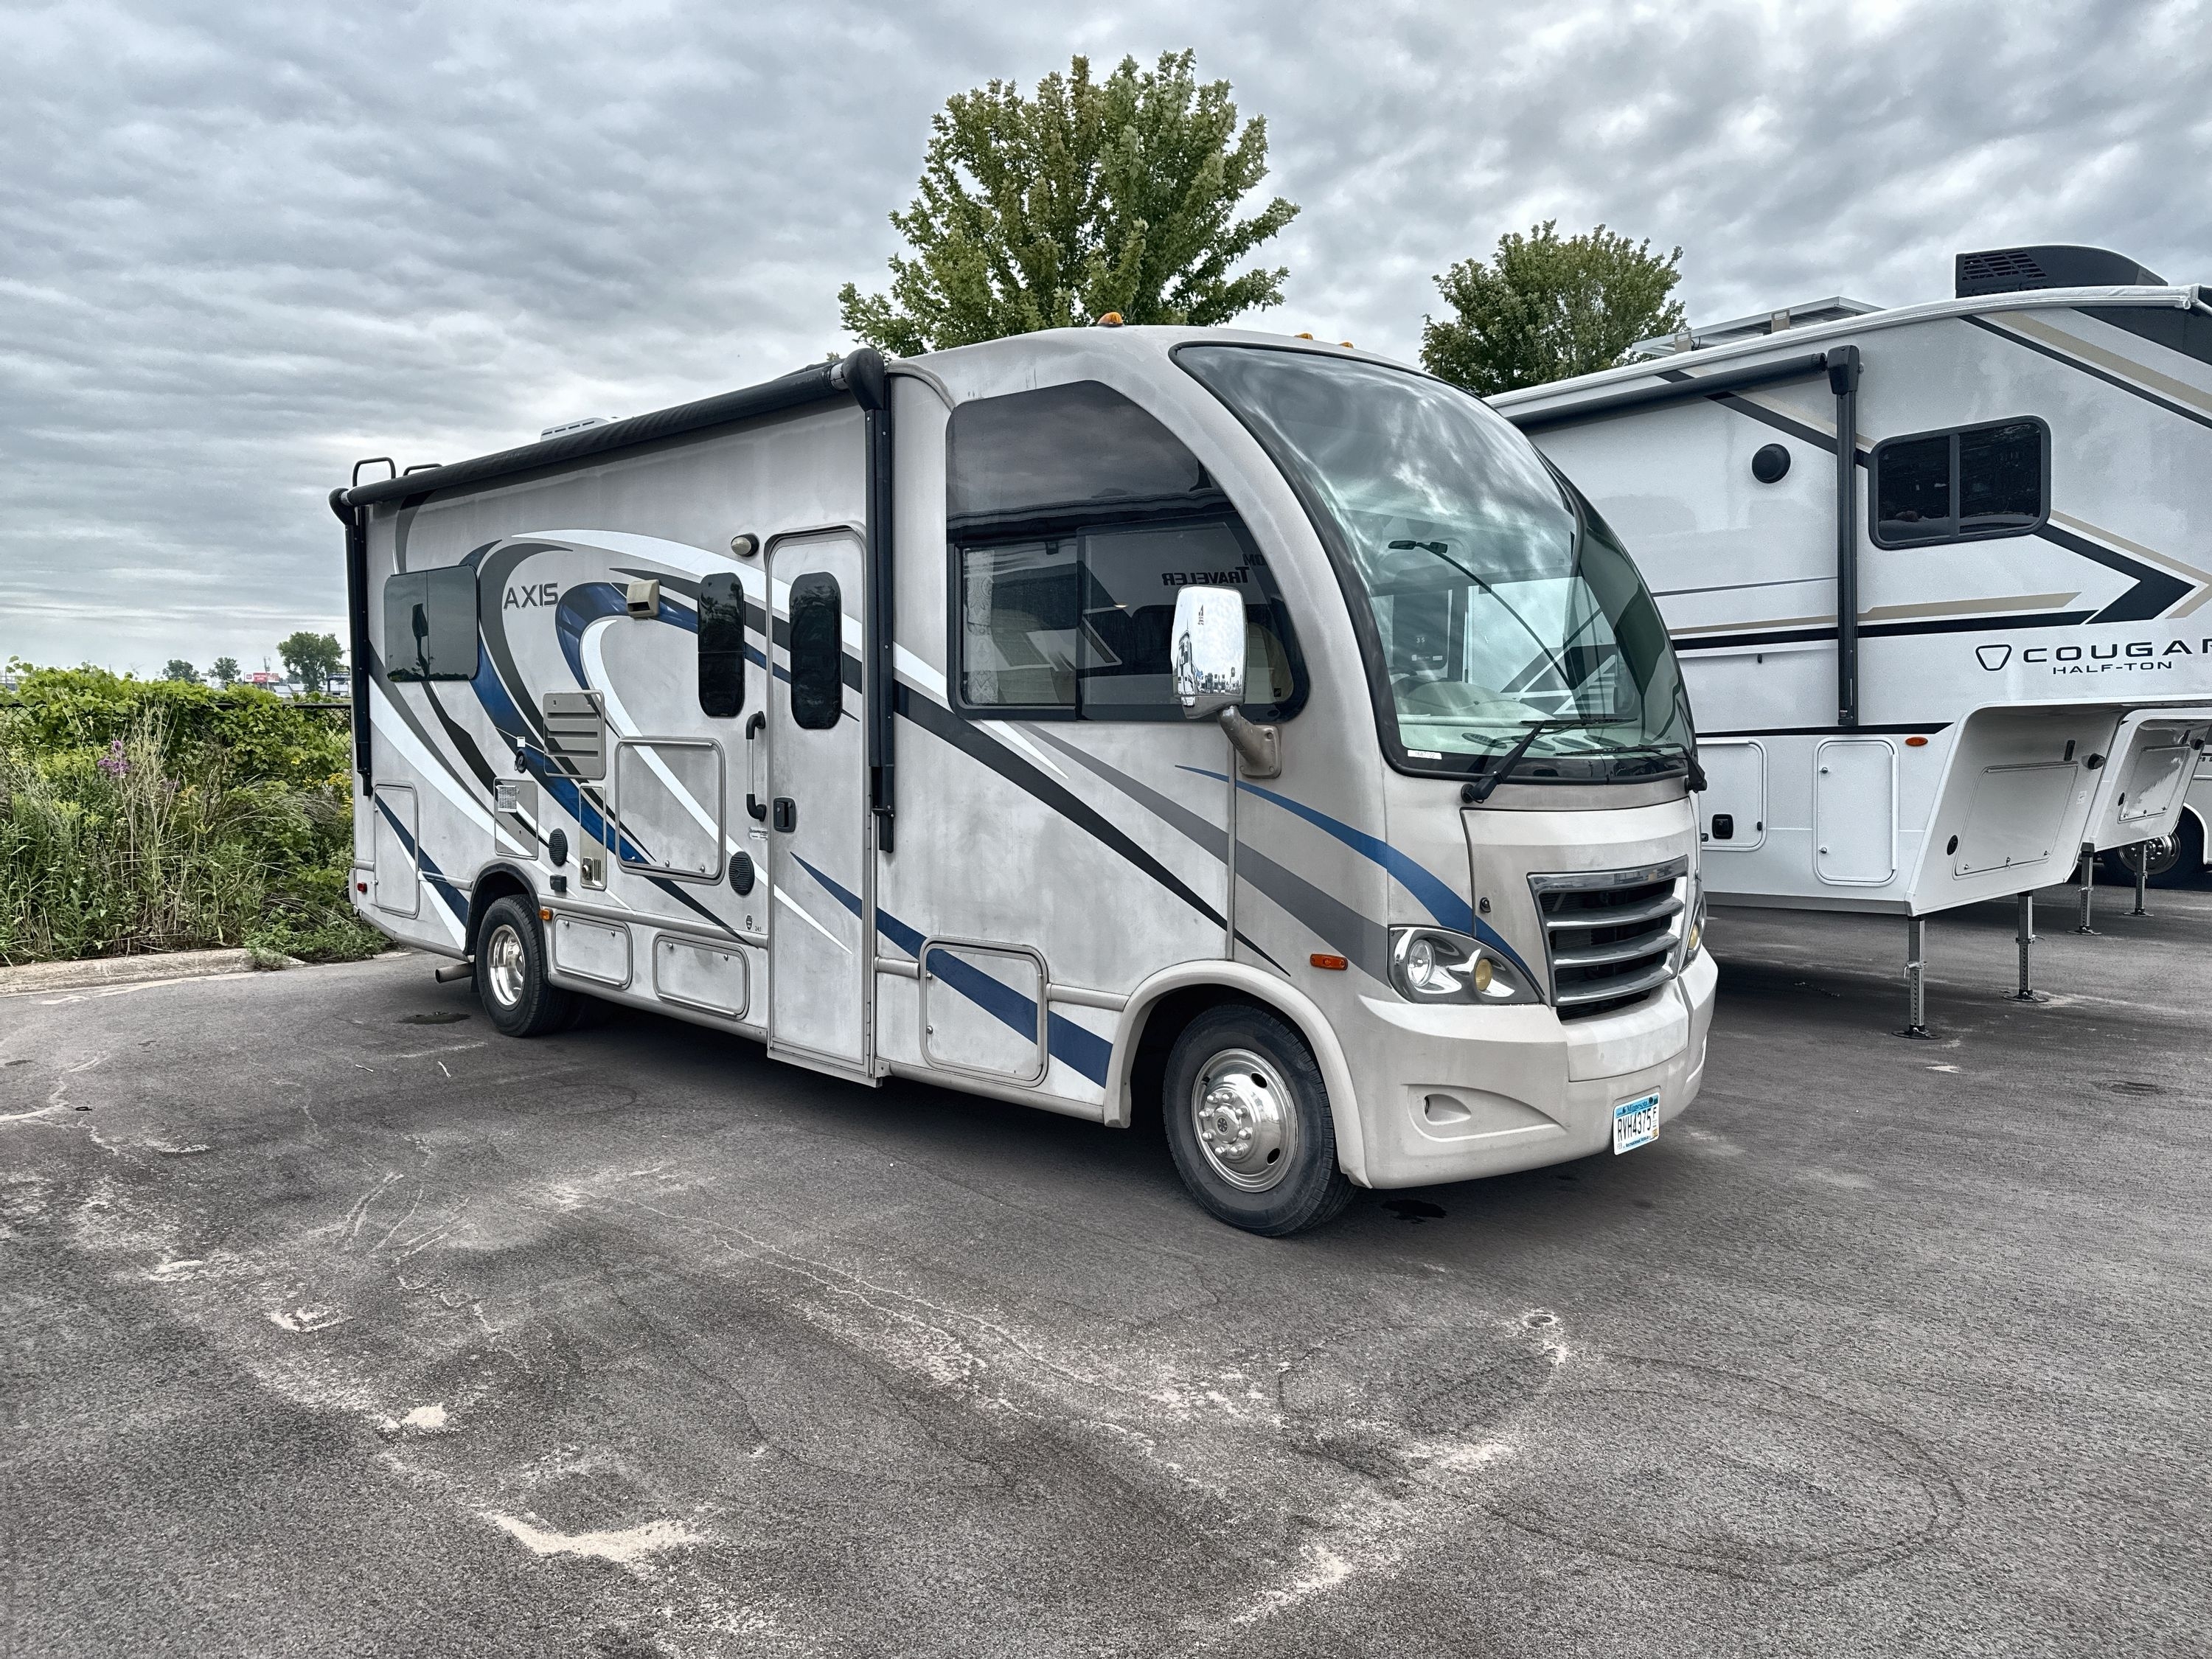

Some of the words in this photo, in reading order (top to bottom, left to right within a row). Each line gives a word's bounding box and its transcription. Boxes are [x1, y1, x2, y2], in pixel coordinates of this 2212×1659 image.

[503, 582, 559, 610] AXIS
[2053, 661, 2172, 675] HALF-TON
[1618, 1107, 1651, 1142] RVH4375
